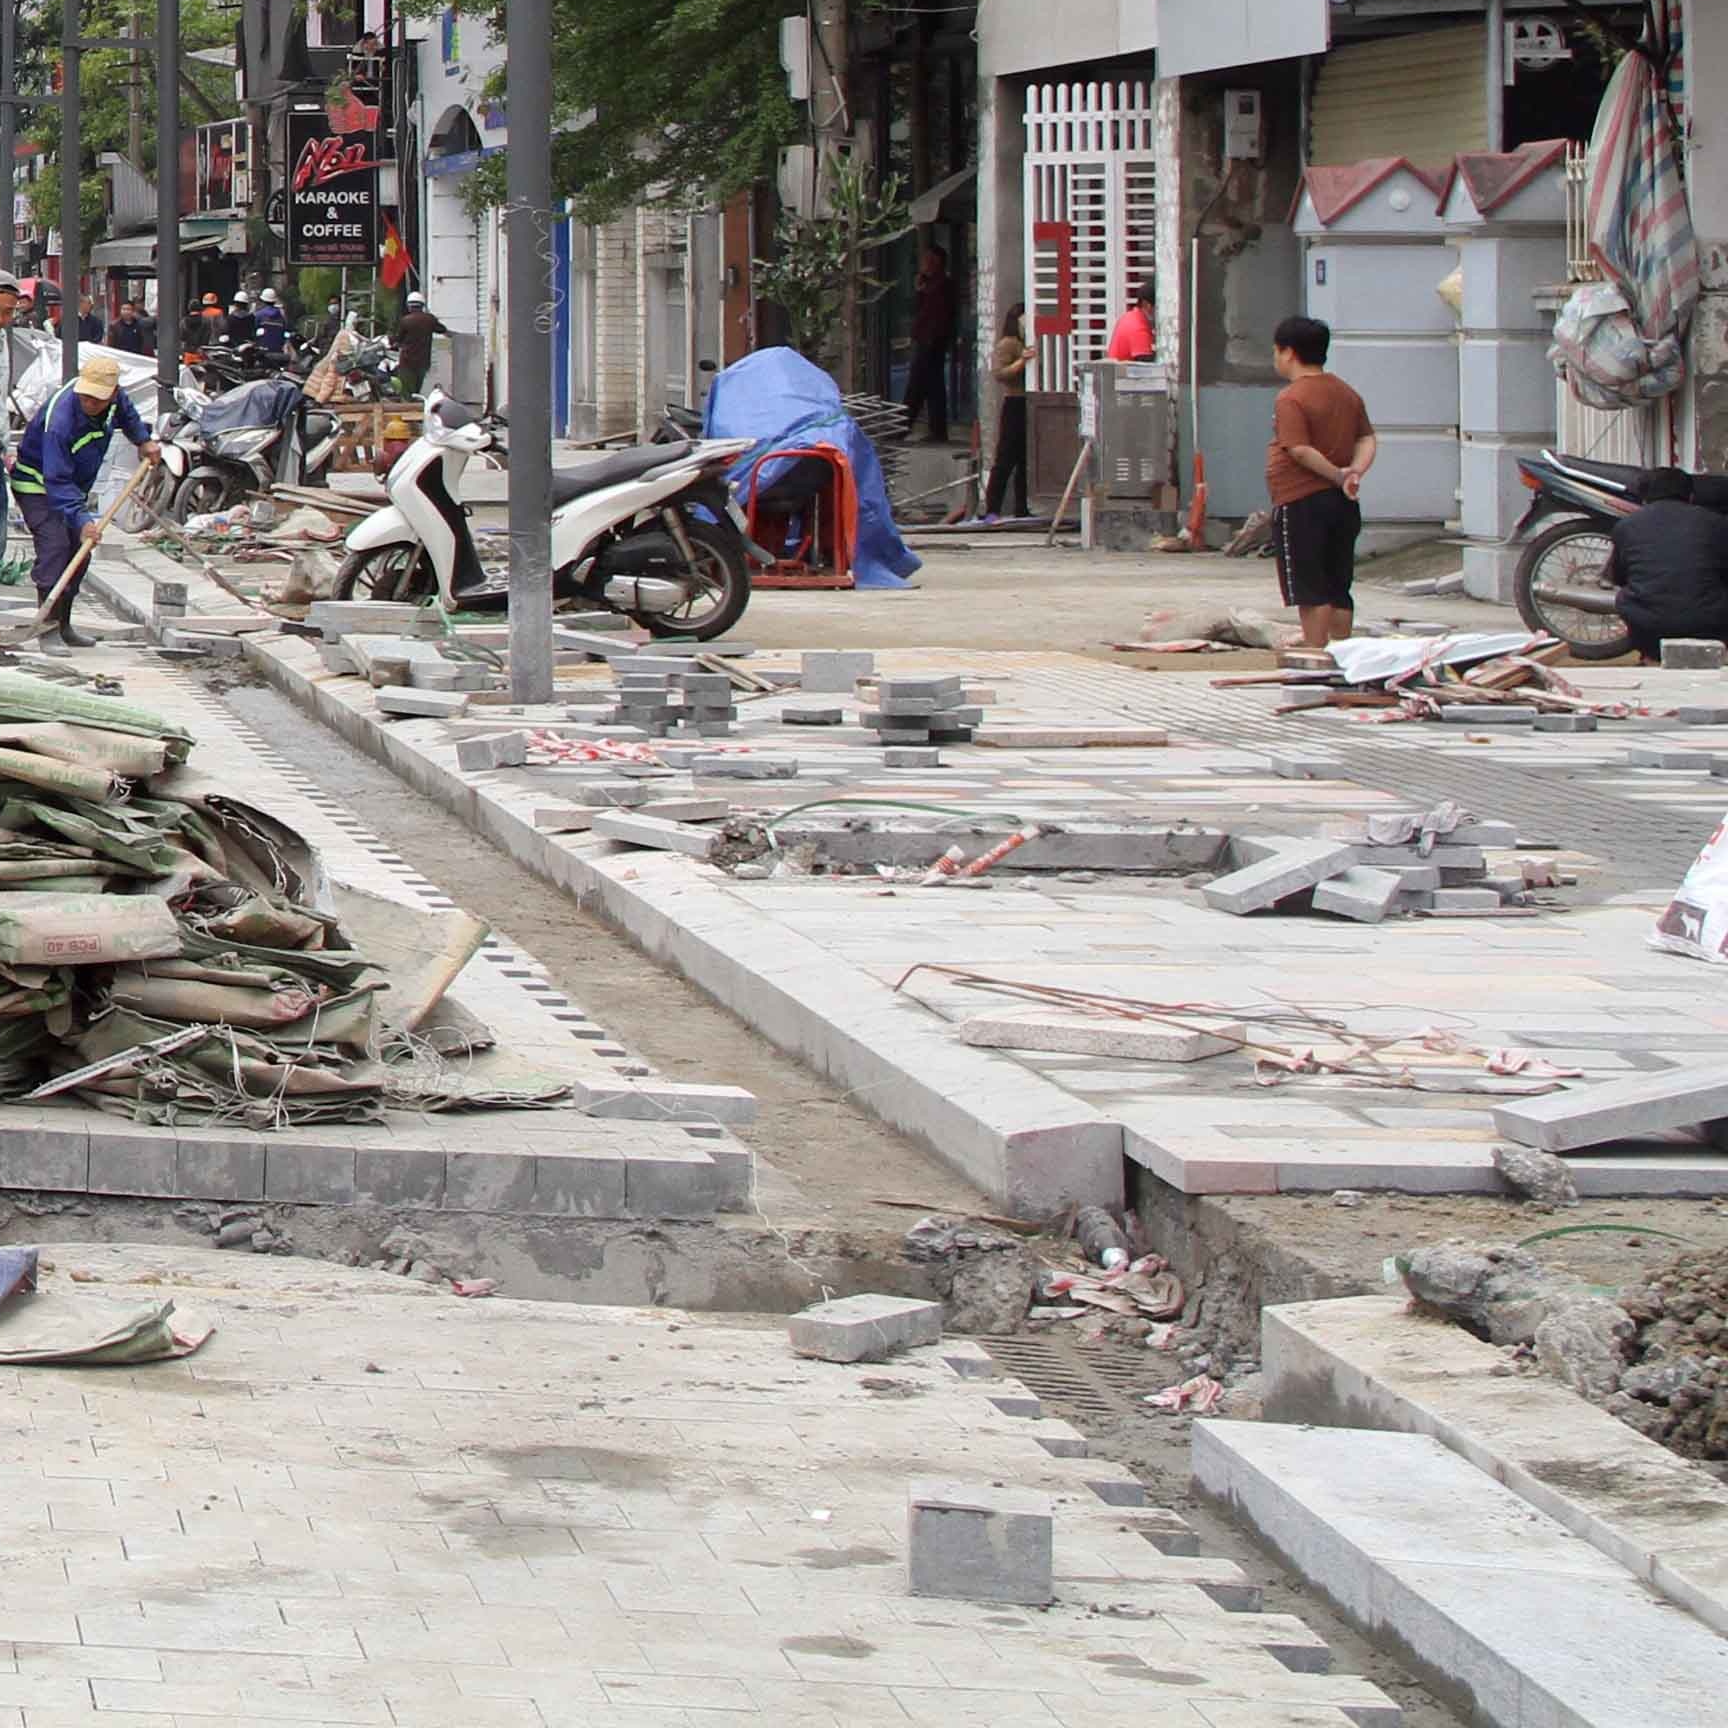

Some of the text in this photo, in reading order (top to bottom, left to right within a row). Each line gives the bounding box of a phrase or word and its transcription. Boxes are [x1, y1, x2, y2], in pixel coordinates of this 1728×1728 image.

[295, 192, 369, 204] KARAOKE
[326, 207, 339, 220] &
[302, 224, 362, 237] COFFEE
